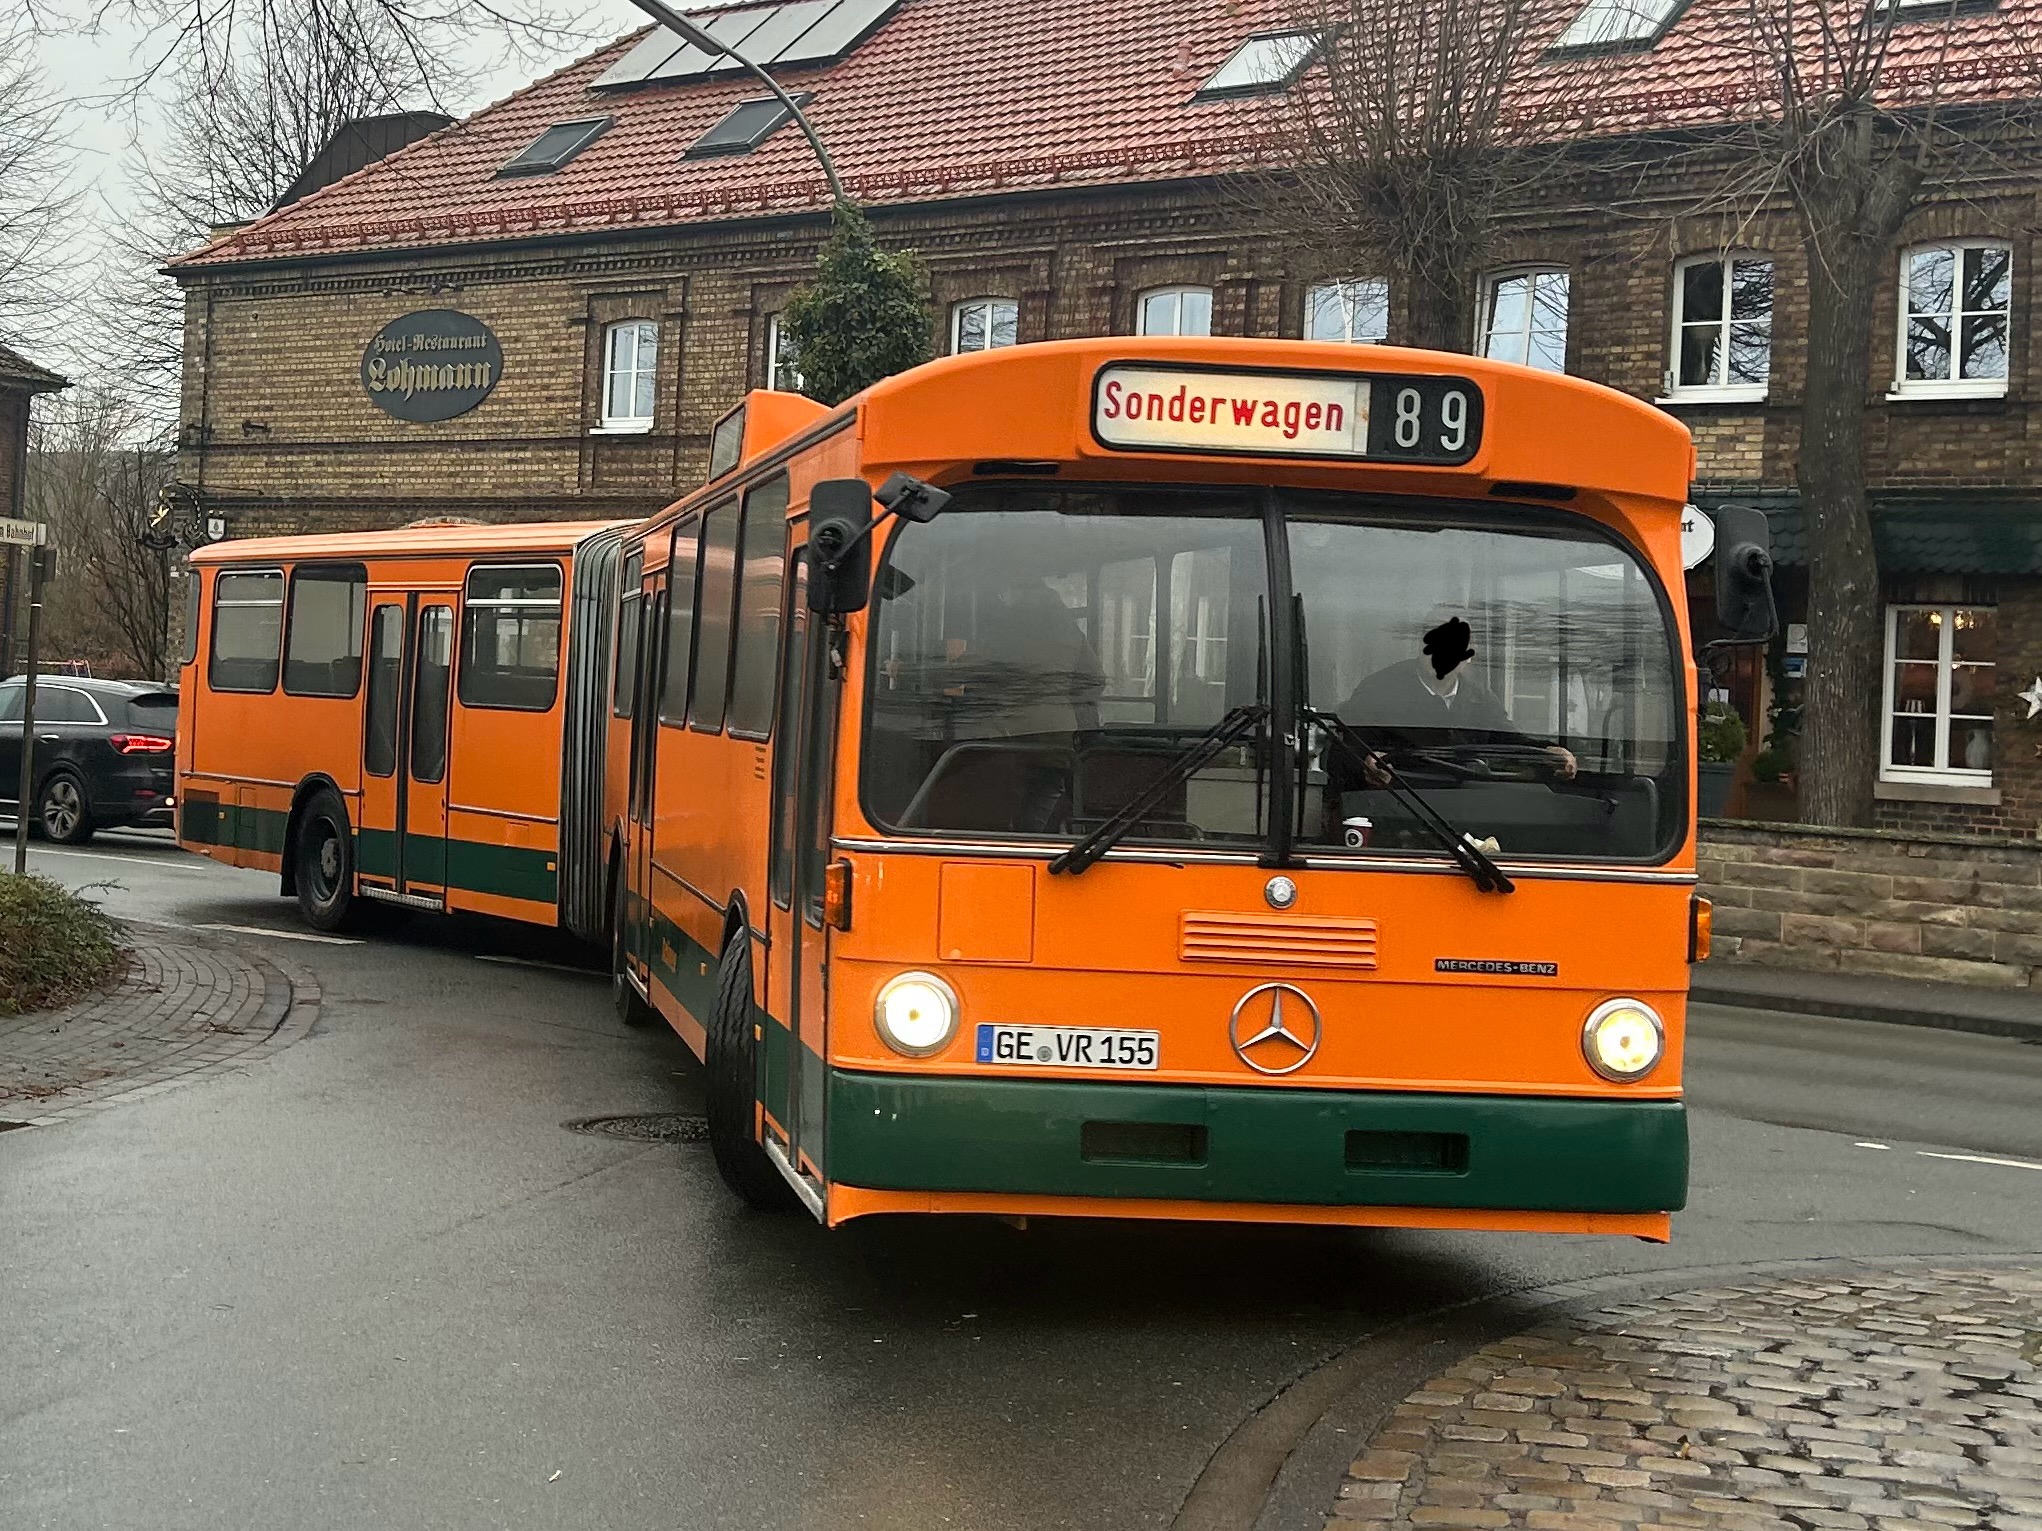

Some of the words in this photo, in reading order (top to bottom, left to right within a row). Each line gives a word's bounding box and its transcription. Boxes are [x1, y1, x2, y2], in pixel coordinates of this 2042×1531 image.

[374, 332, 487, 354] Hotel-Restaurant
[368, 357, 491, 402] Lohmann
[1104, 381, 1344, 439] Sonderwagen
[1394, 387, 1467, 451] 89
[996, 1031, 1034, 1060] GE
[1056, 1033, 1093, 1063] VR
[1100, 1036, 1155, 1065] 155
